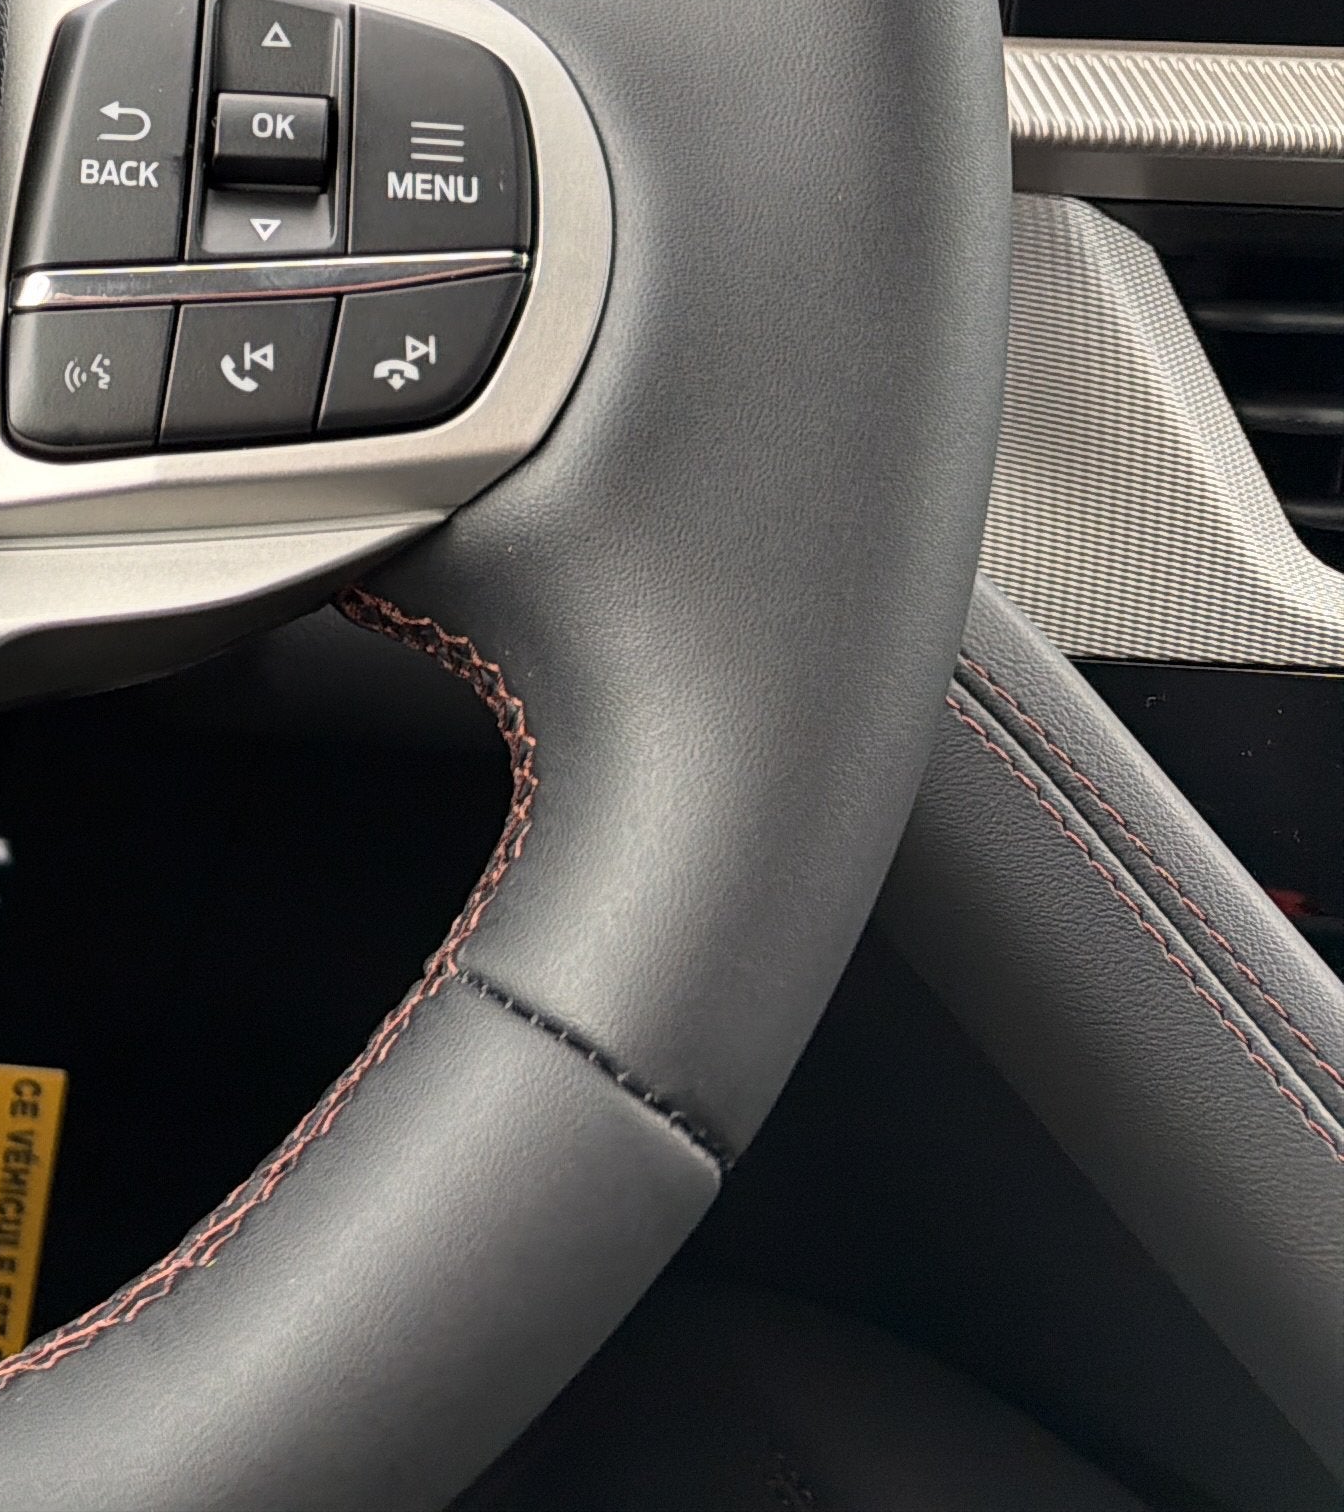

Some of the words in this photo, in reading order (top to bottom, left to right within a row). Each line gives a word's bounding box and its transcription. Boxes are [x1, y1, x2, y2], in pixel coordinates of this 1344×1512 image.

[251, 112, 296, 141] OK
[79, 158, 160, 189] BACK
[386, 171, 480, 205] MENU
[10, 1077, 43, 1119] CE
